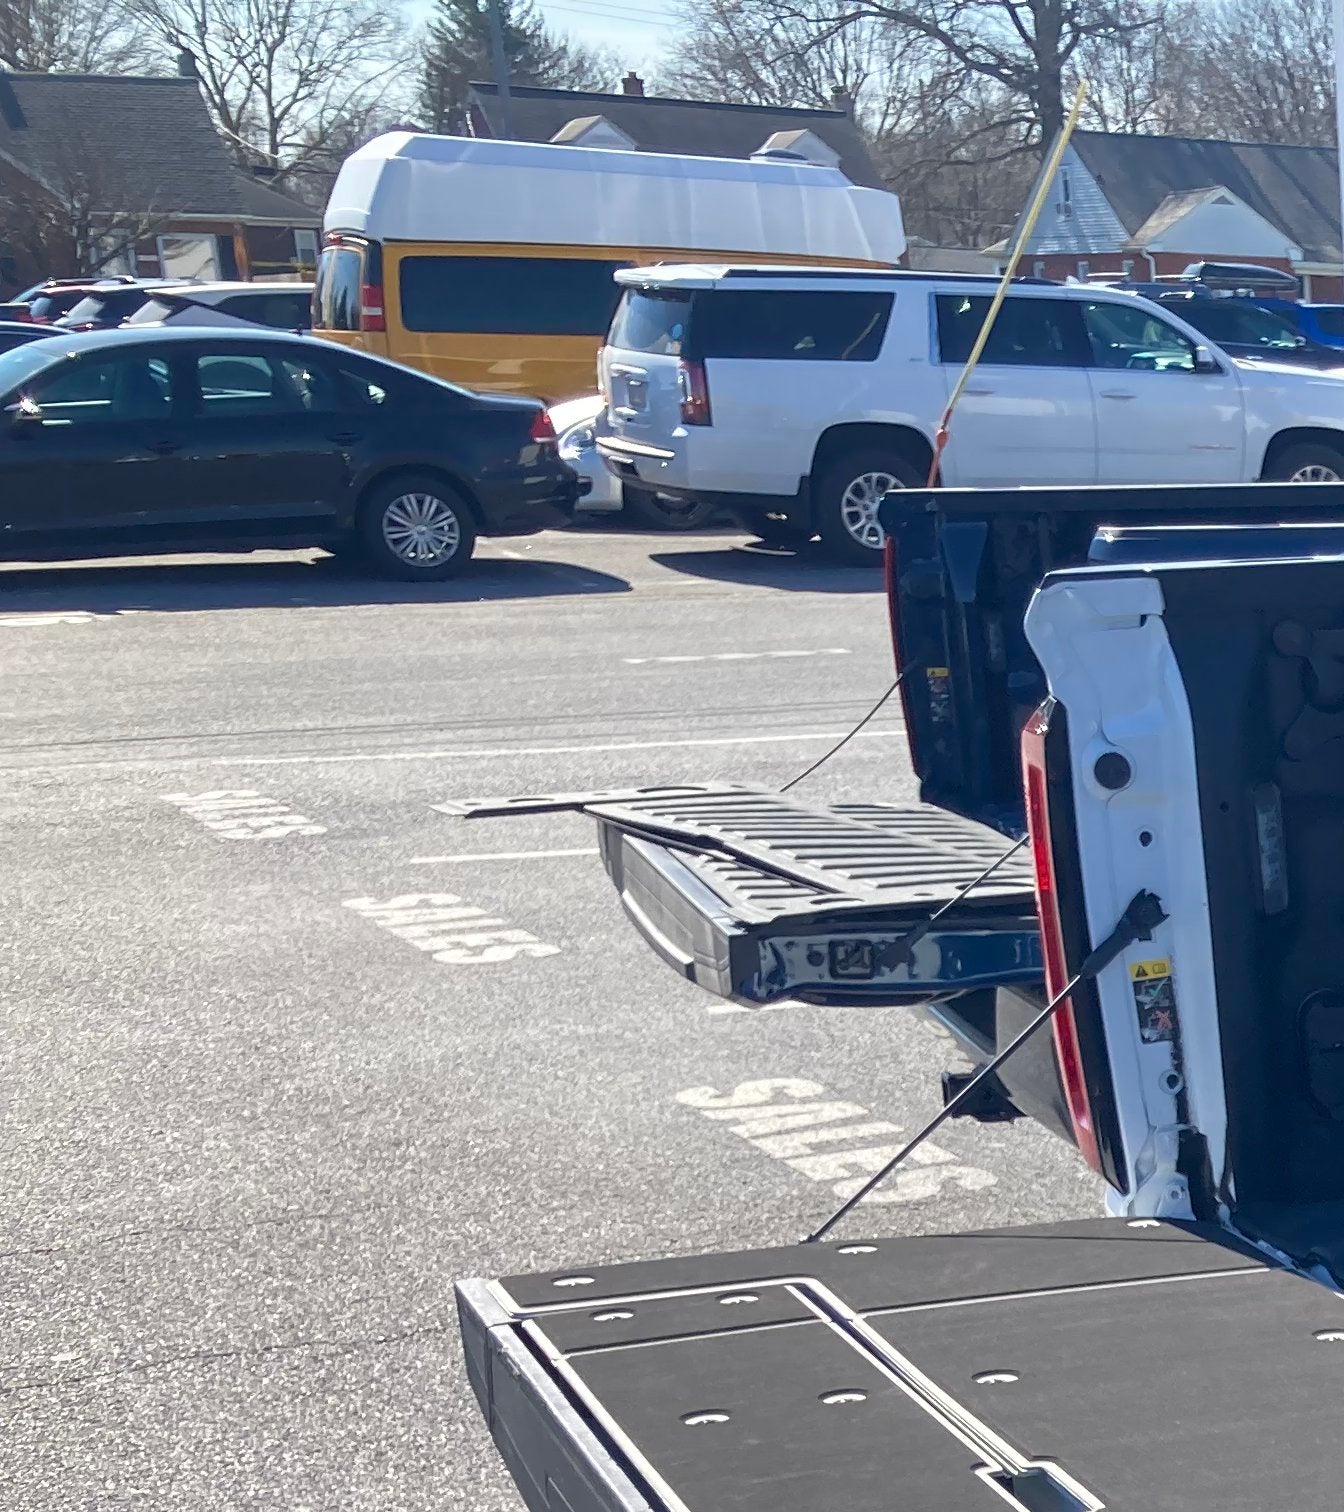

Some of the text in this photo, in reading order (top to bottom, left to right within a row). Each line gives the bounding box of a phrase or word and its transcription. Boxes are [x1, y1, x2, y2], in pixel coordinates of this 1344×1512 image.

[159, 789, 328, 839] SALES
[341, 893, 563, 964] SALES
[675, 1077, 999, 1204] SALES
